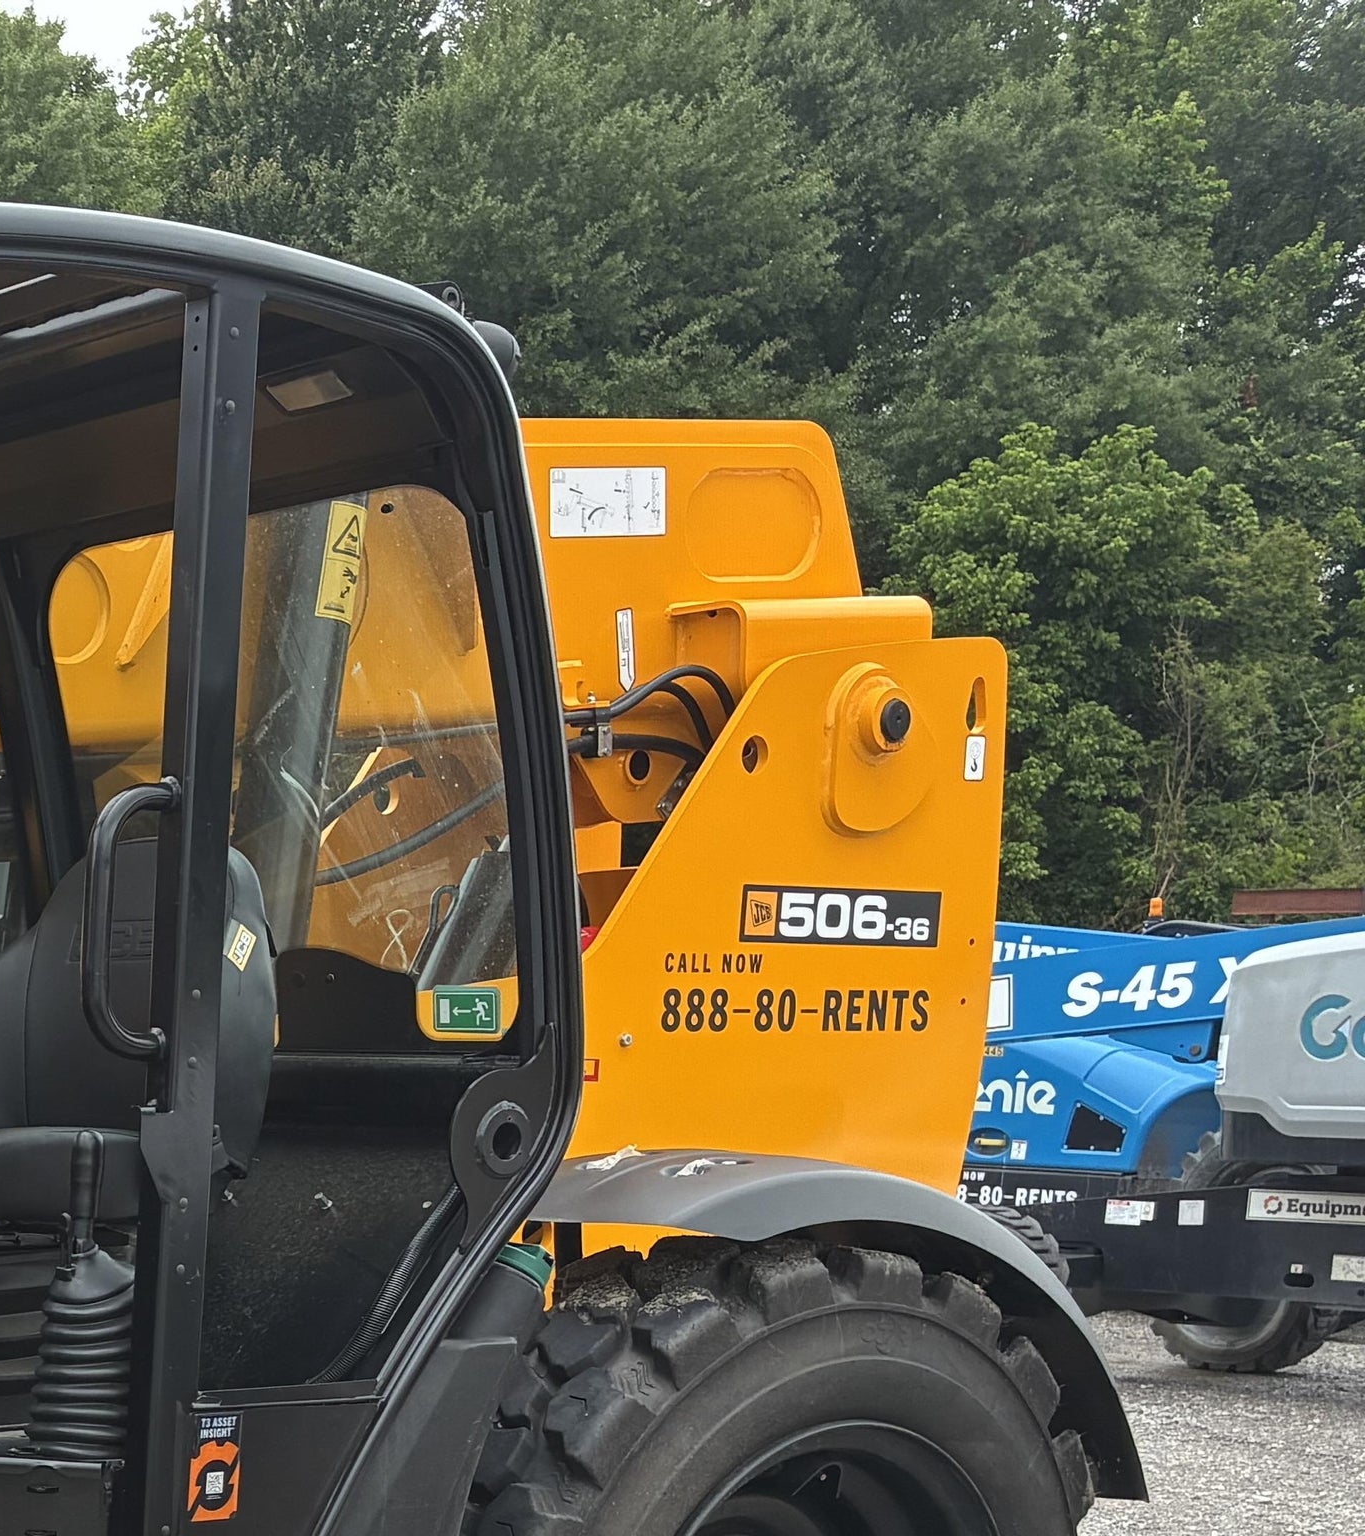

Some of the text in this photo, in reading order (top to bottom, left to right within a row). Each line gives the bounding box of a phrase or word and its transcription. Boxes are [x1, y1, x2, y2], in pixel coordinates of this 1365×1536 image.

[779, 892, 930, 940] 506-36
[664, 953, 763, 973] CALL NOW
[1062, 961, 1196, 1018] S-45
[661, 988, 930, 1032] 888-80-RENTS
[962, 1171, 986, 1181] NOW
[1286, 1198, 1365, 1218] Equipm
[201, 1416, 237, 1428] T3 ASSET
[200, 1426, 235, 1439] INSIGHT
